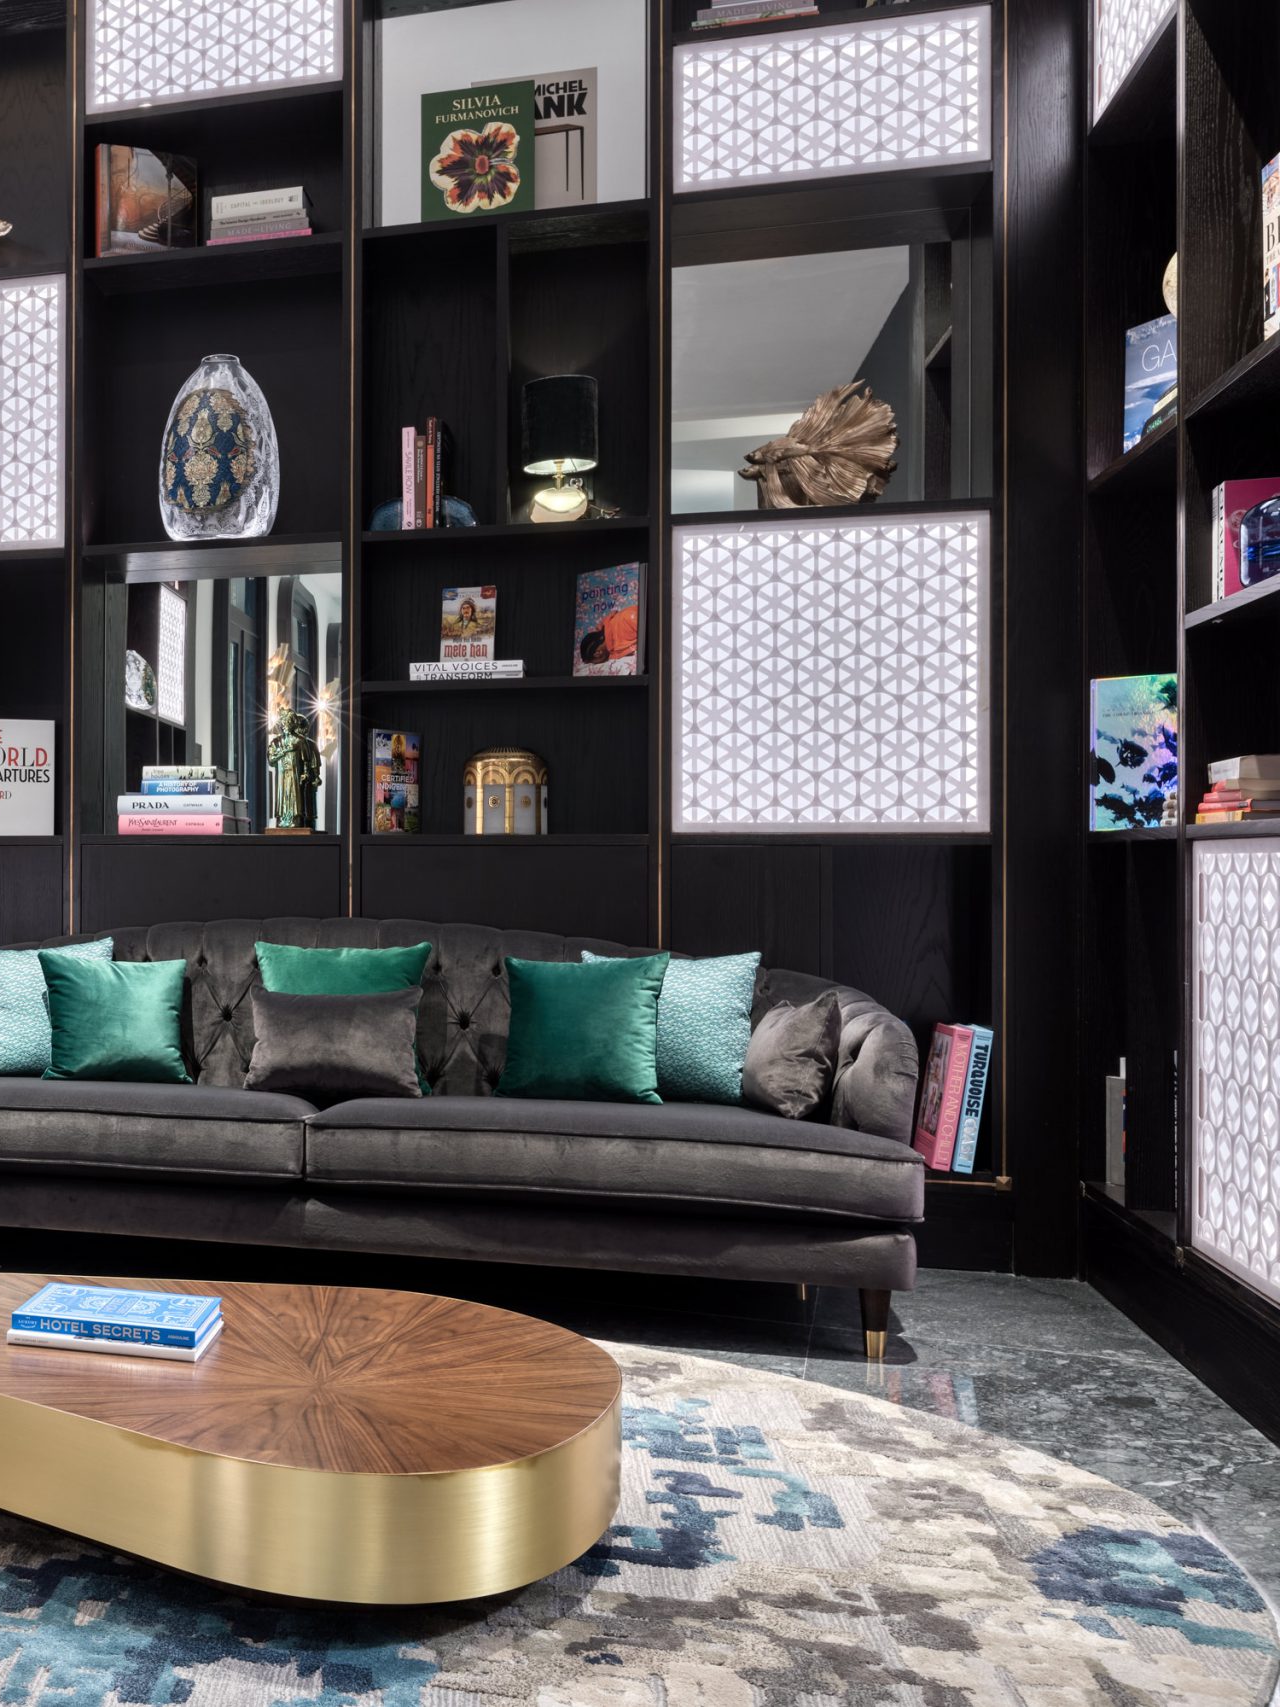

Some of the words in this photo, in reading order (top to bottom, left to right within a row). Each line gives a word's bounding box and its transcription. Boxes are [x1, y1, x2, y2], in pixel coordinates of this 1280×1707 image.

[717, 8, 746, 17] MADE
[756, 2, 793, 12] LIVING
[452, 94, 501, 111] SILVIA
[534, 92, 588, 121] ANK
[435, 105, 519, 124] FURMANOVICH
[227, 227, 253, 236] MADE
[261, 222, 292, 232] LIVING
[1141, 339, 1177, 372] GA
[404, 451, 413, 474] SAVILE
[404, 476, 413, 495] ROW
[581, 582, 629, 604] painting
[593, 600, 616, 613] now
[443, 643, 467, 659] mete
[469, 642, 488, 659] han
[414, 663, 448, 672] VITAL
[452, 662, 498, 671] VOICES
[424, 671, 493, 681] TRANSFORM
[381, 774, 415, 783] CERTIFIED
[132, 801, 170, 809] PRADA
[948, 1042, 969, 1094] MOTHER
[965, 1044, 990, 1118] TURQUOISE
[943, 1095, 960, 1123] AND
[937, 1124, 954, 1161] CHILD
[958, 1117, 978, 1162] COAST
[40, 1318, 89, 1335] HOTEL
[92, 1324, 161, 1341] SECRETS
